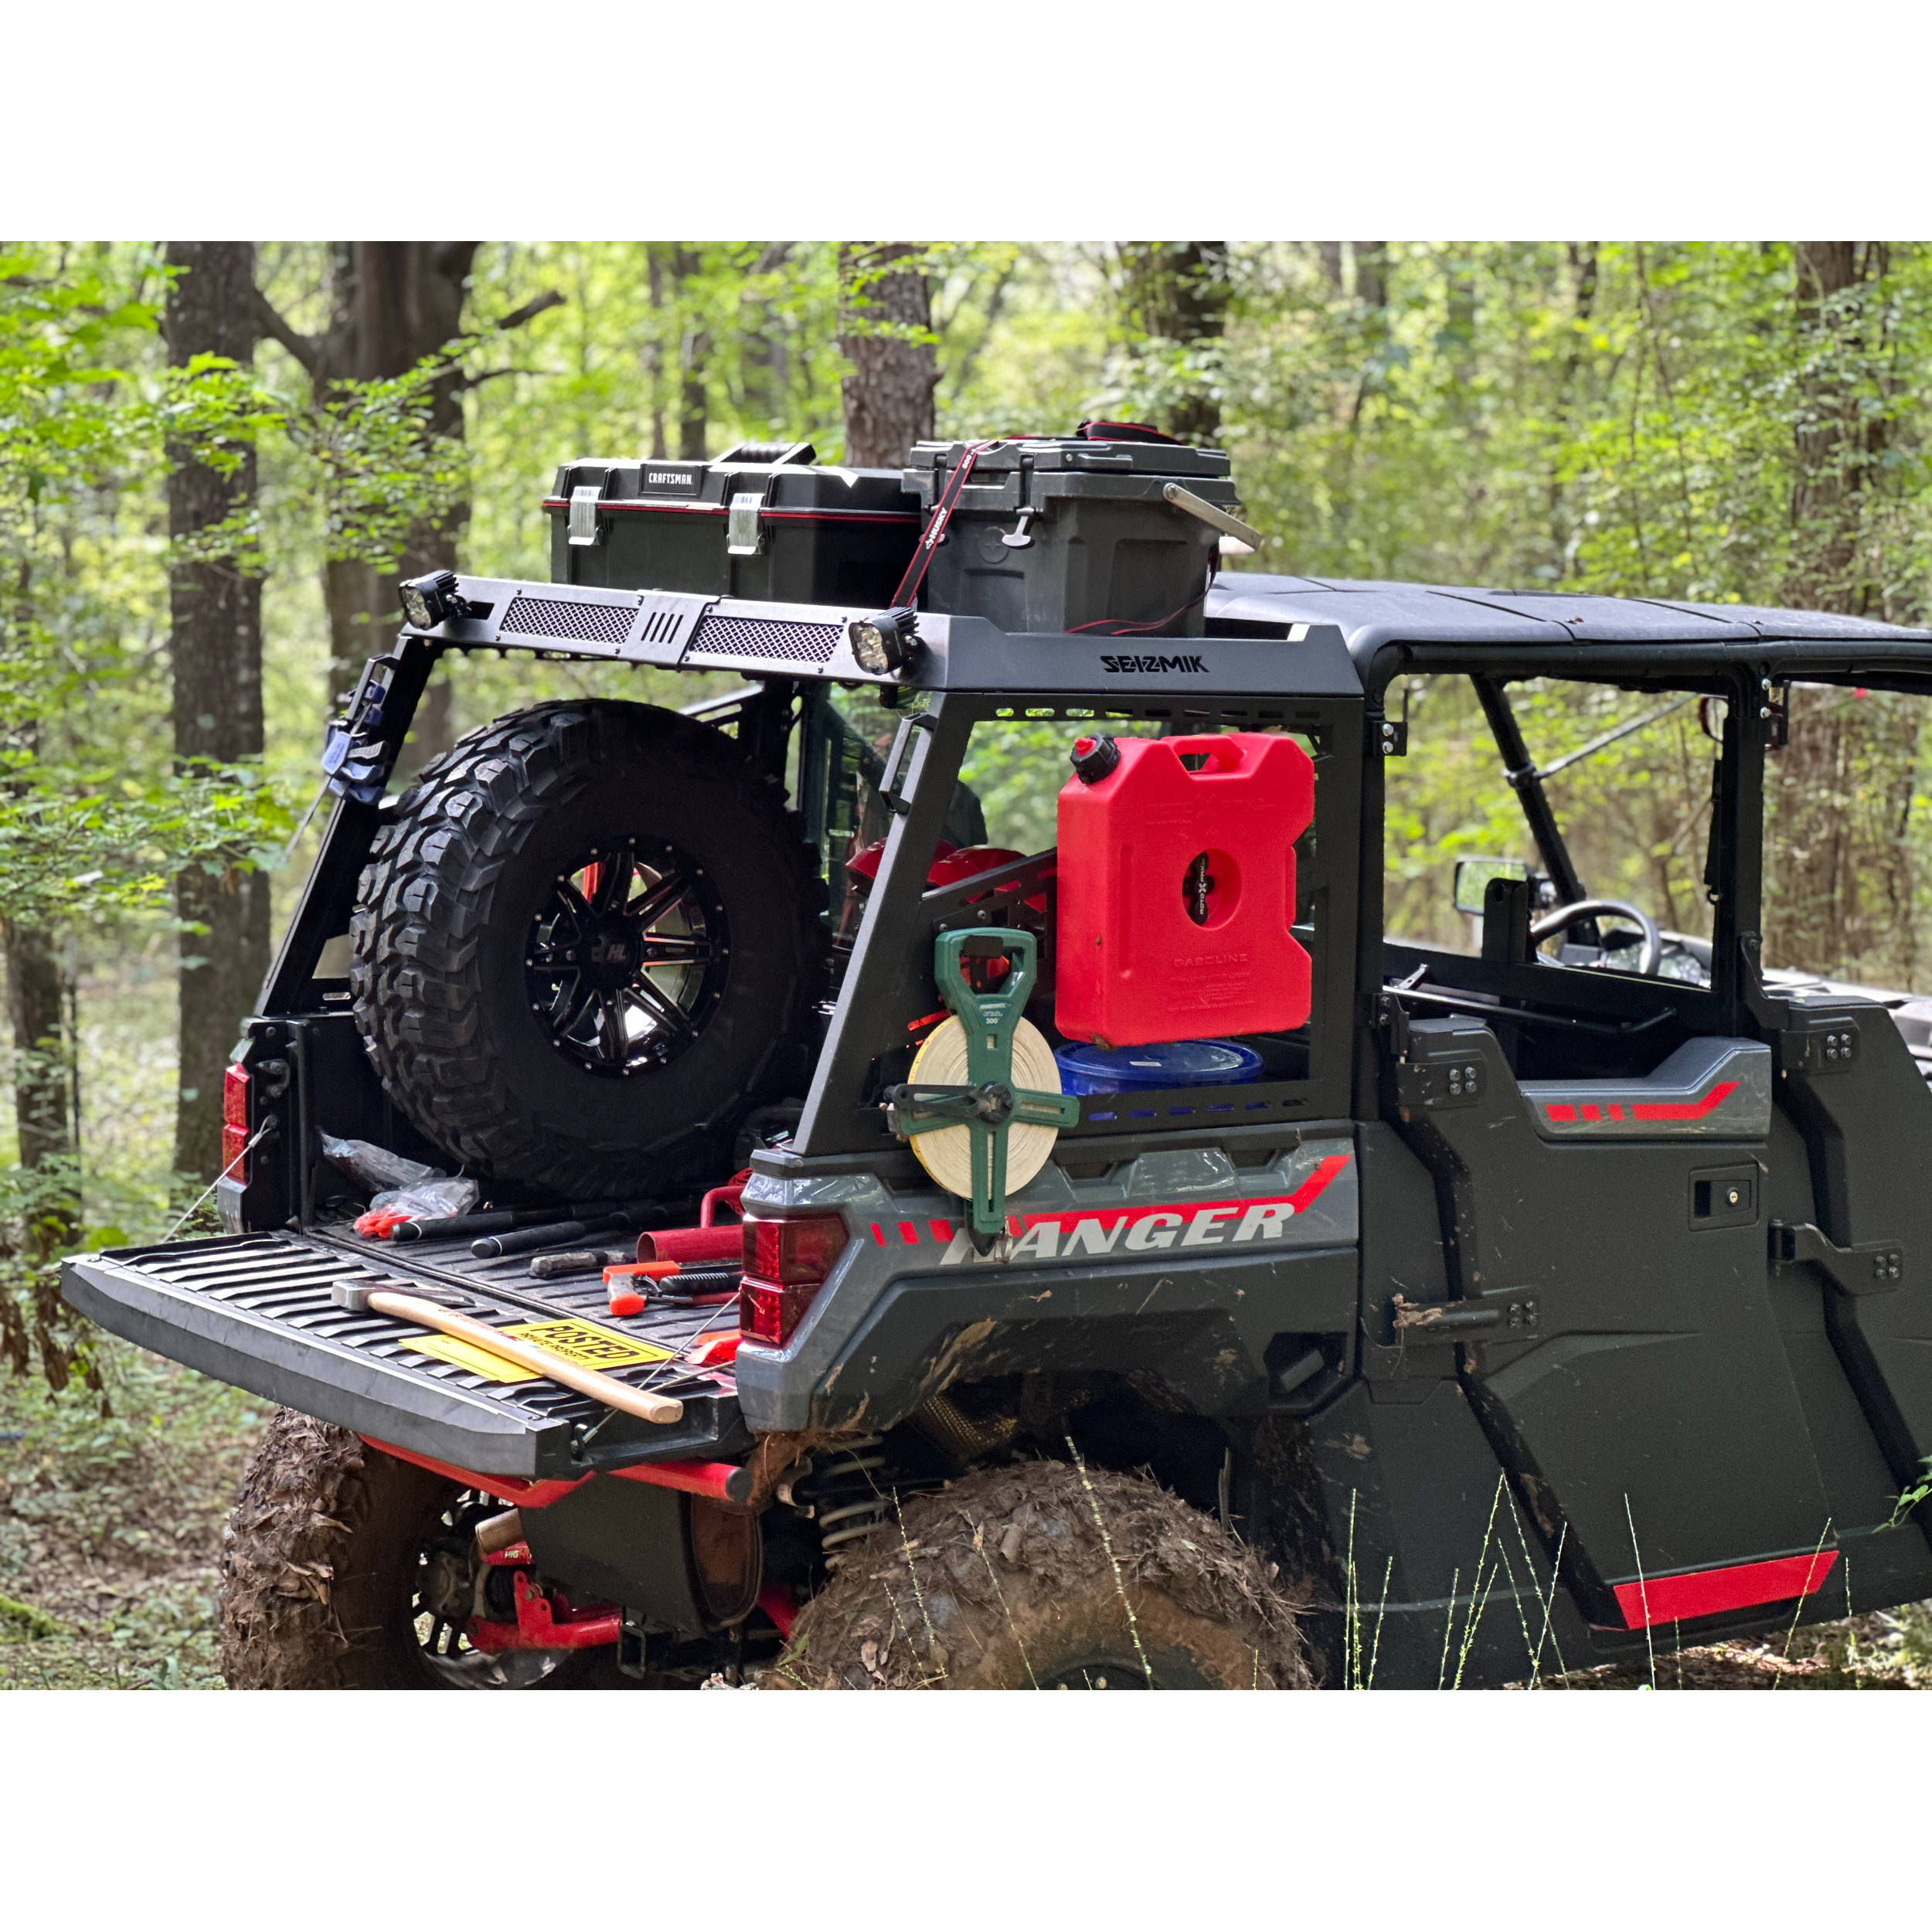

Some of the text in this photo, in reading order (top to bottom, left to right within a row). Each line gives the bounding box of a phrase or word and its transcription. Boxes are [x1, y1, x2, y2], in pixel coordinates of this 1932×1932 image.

[648, 472, 692, 485] CRAFTSMAN
[930, 507, 947, 539] HUSKY
[1100, 655, 1210, 673] SEIZMIK
[1174, 953, 1248, 967] GASOLINE
[529, 1325, 641, 1360] POSTED
[549, 1345, 591, 1360] PROPERTY
